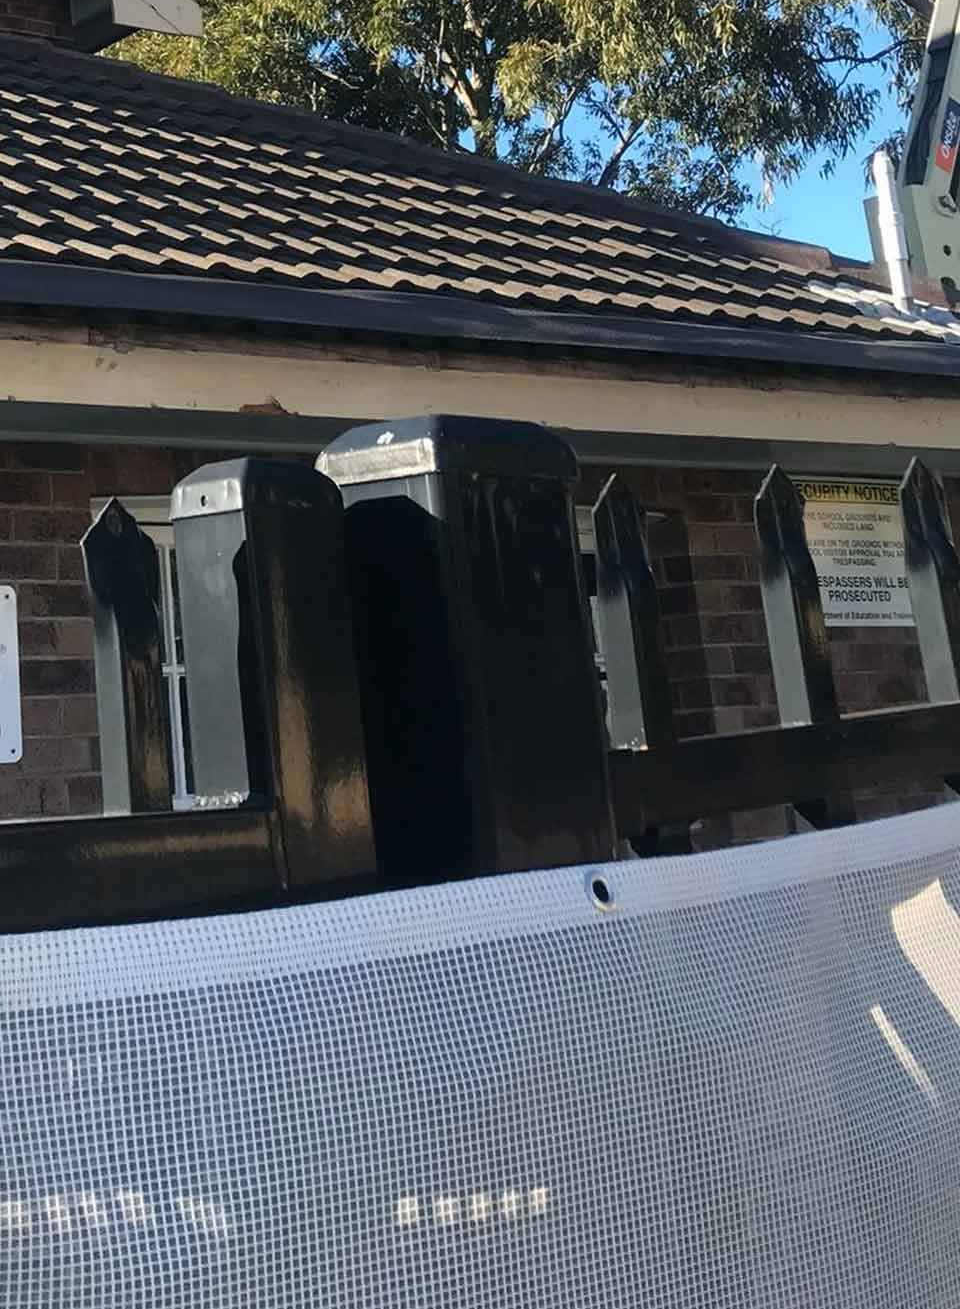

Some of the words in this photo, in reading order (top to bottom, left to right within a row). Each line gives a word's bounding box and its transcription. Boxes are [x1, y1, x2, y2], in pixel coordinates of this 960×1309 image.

[797, 483, 850, 500] ECURITY
[854, 485, 898, 501] NOTICE
[818, 576, 872, 588] ESPASSERS
[874, 576, 896, 588] WILL
[898, 577, 910, 588] BE
[829, 590, 891, 602] PROSECUTED
